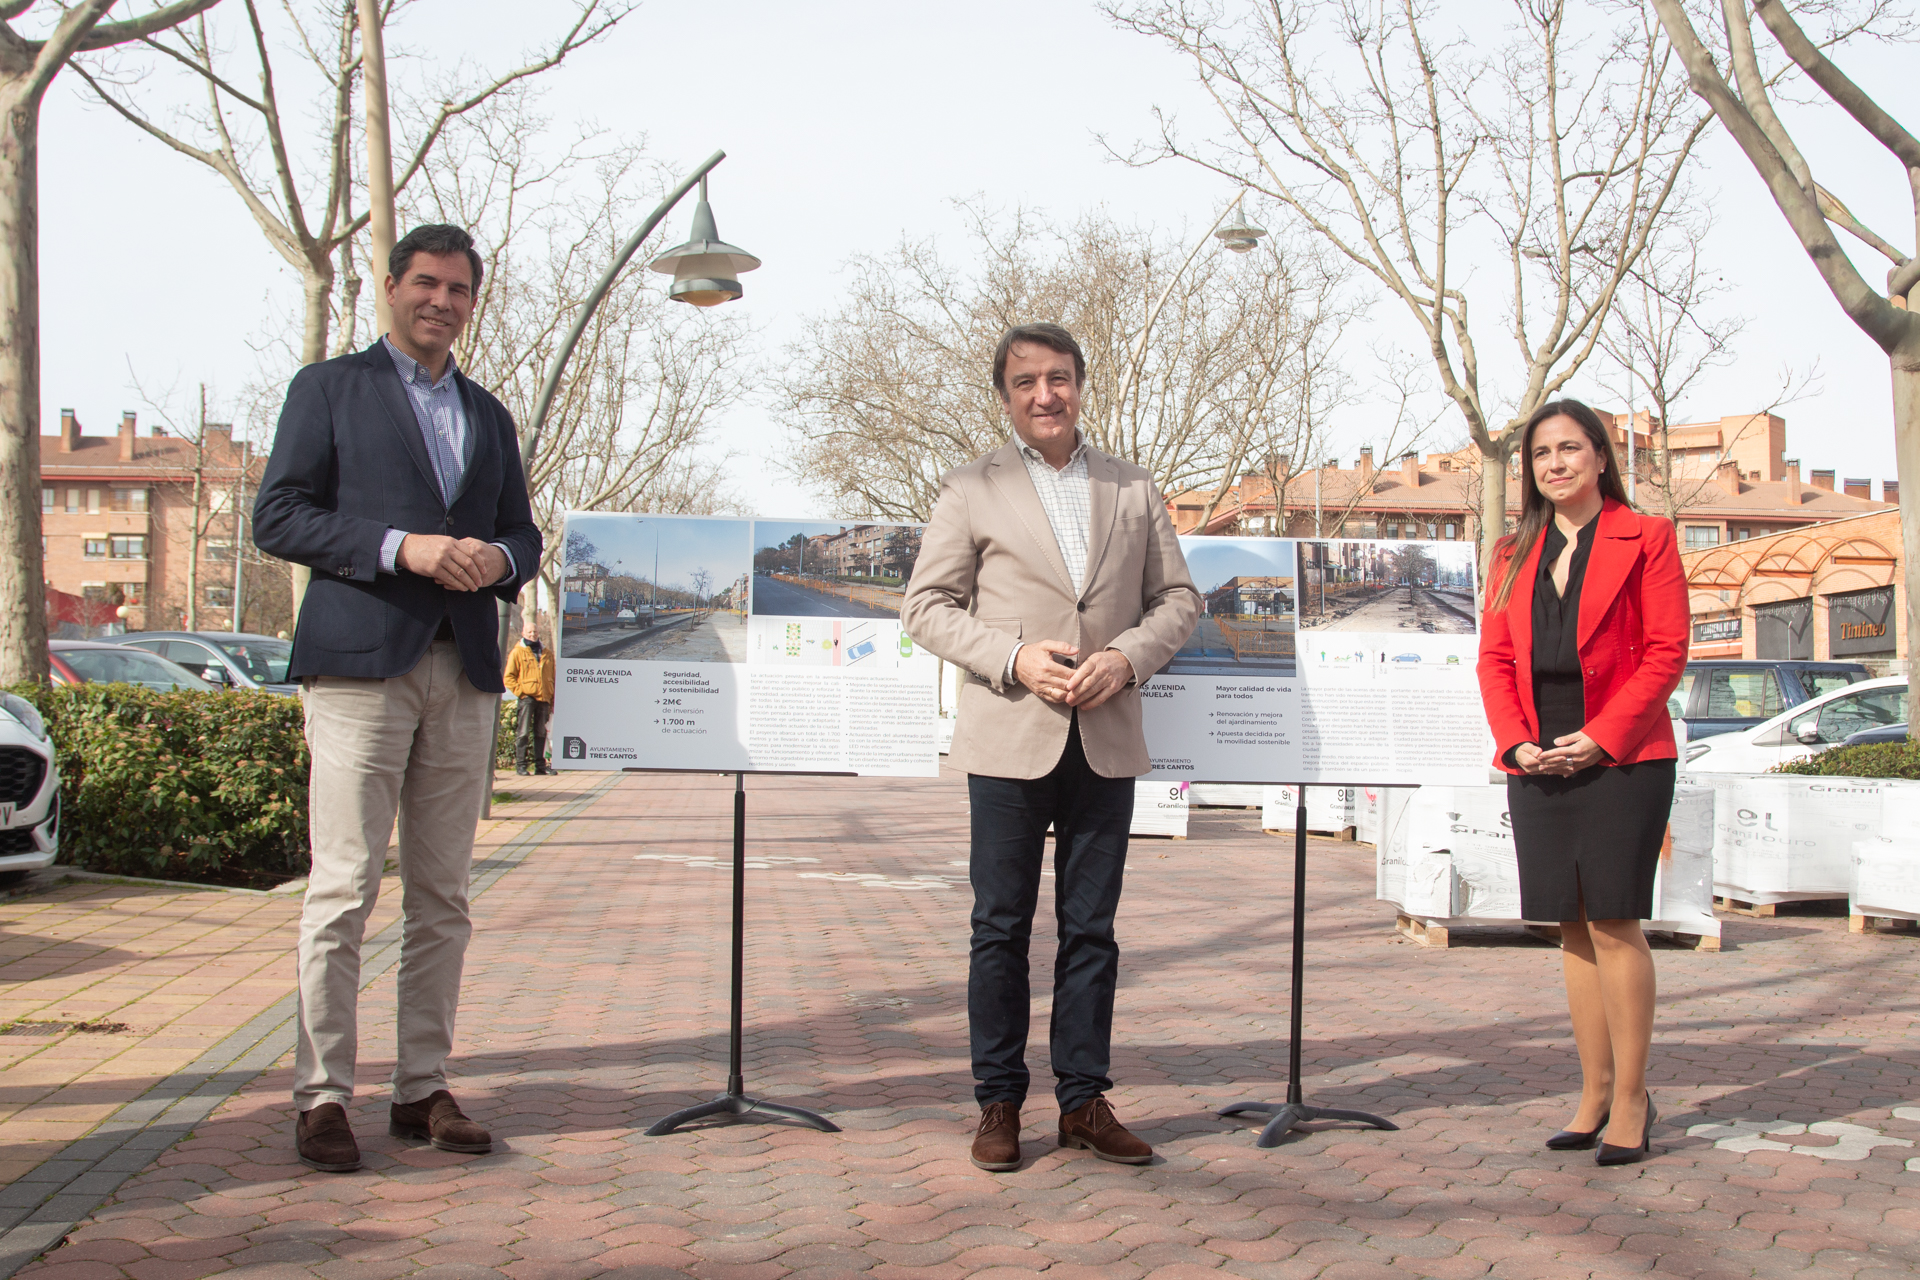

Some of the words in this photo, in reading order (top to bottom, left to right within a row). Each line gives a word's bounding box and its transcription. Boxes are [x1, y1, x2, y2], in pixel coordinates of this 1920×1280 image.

[1840, 621, 1886, 640] Tintineo
[580, 675, 619, 683] VIÑUELAS
[1718, 823, 1816, 847] Granilouro
